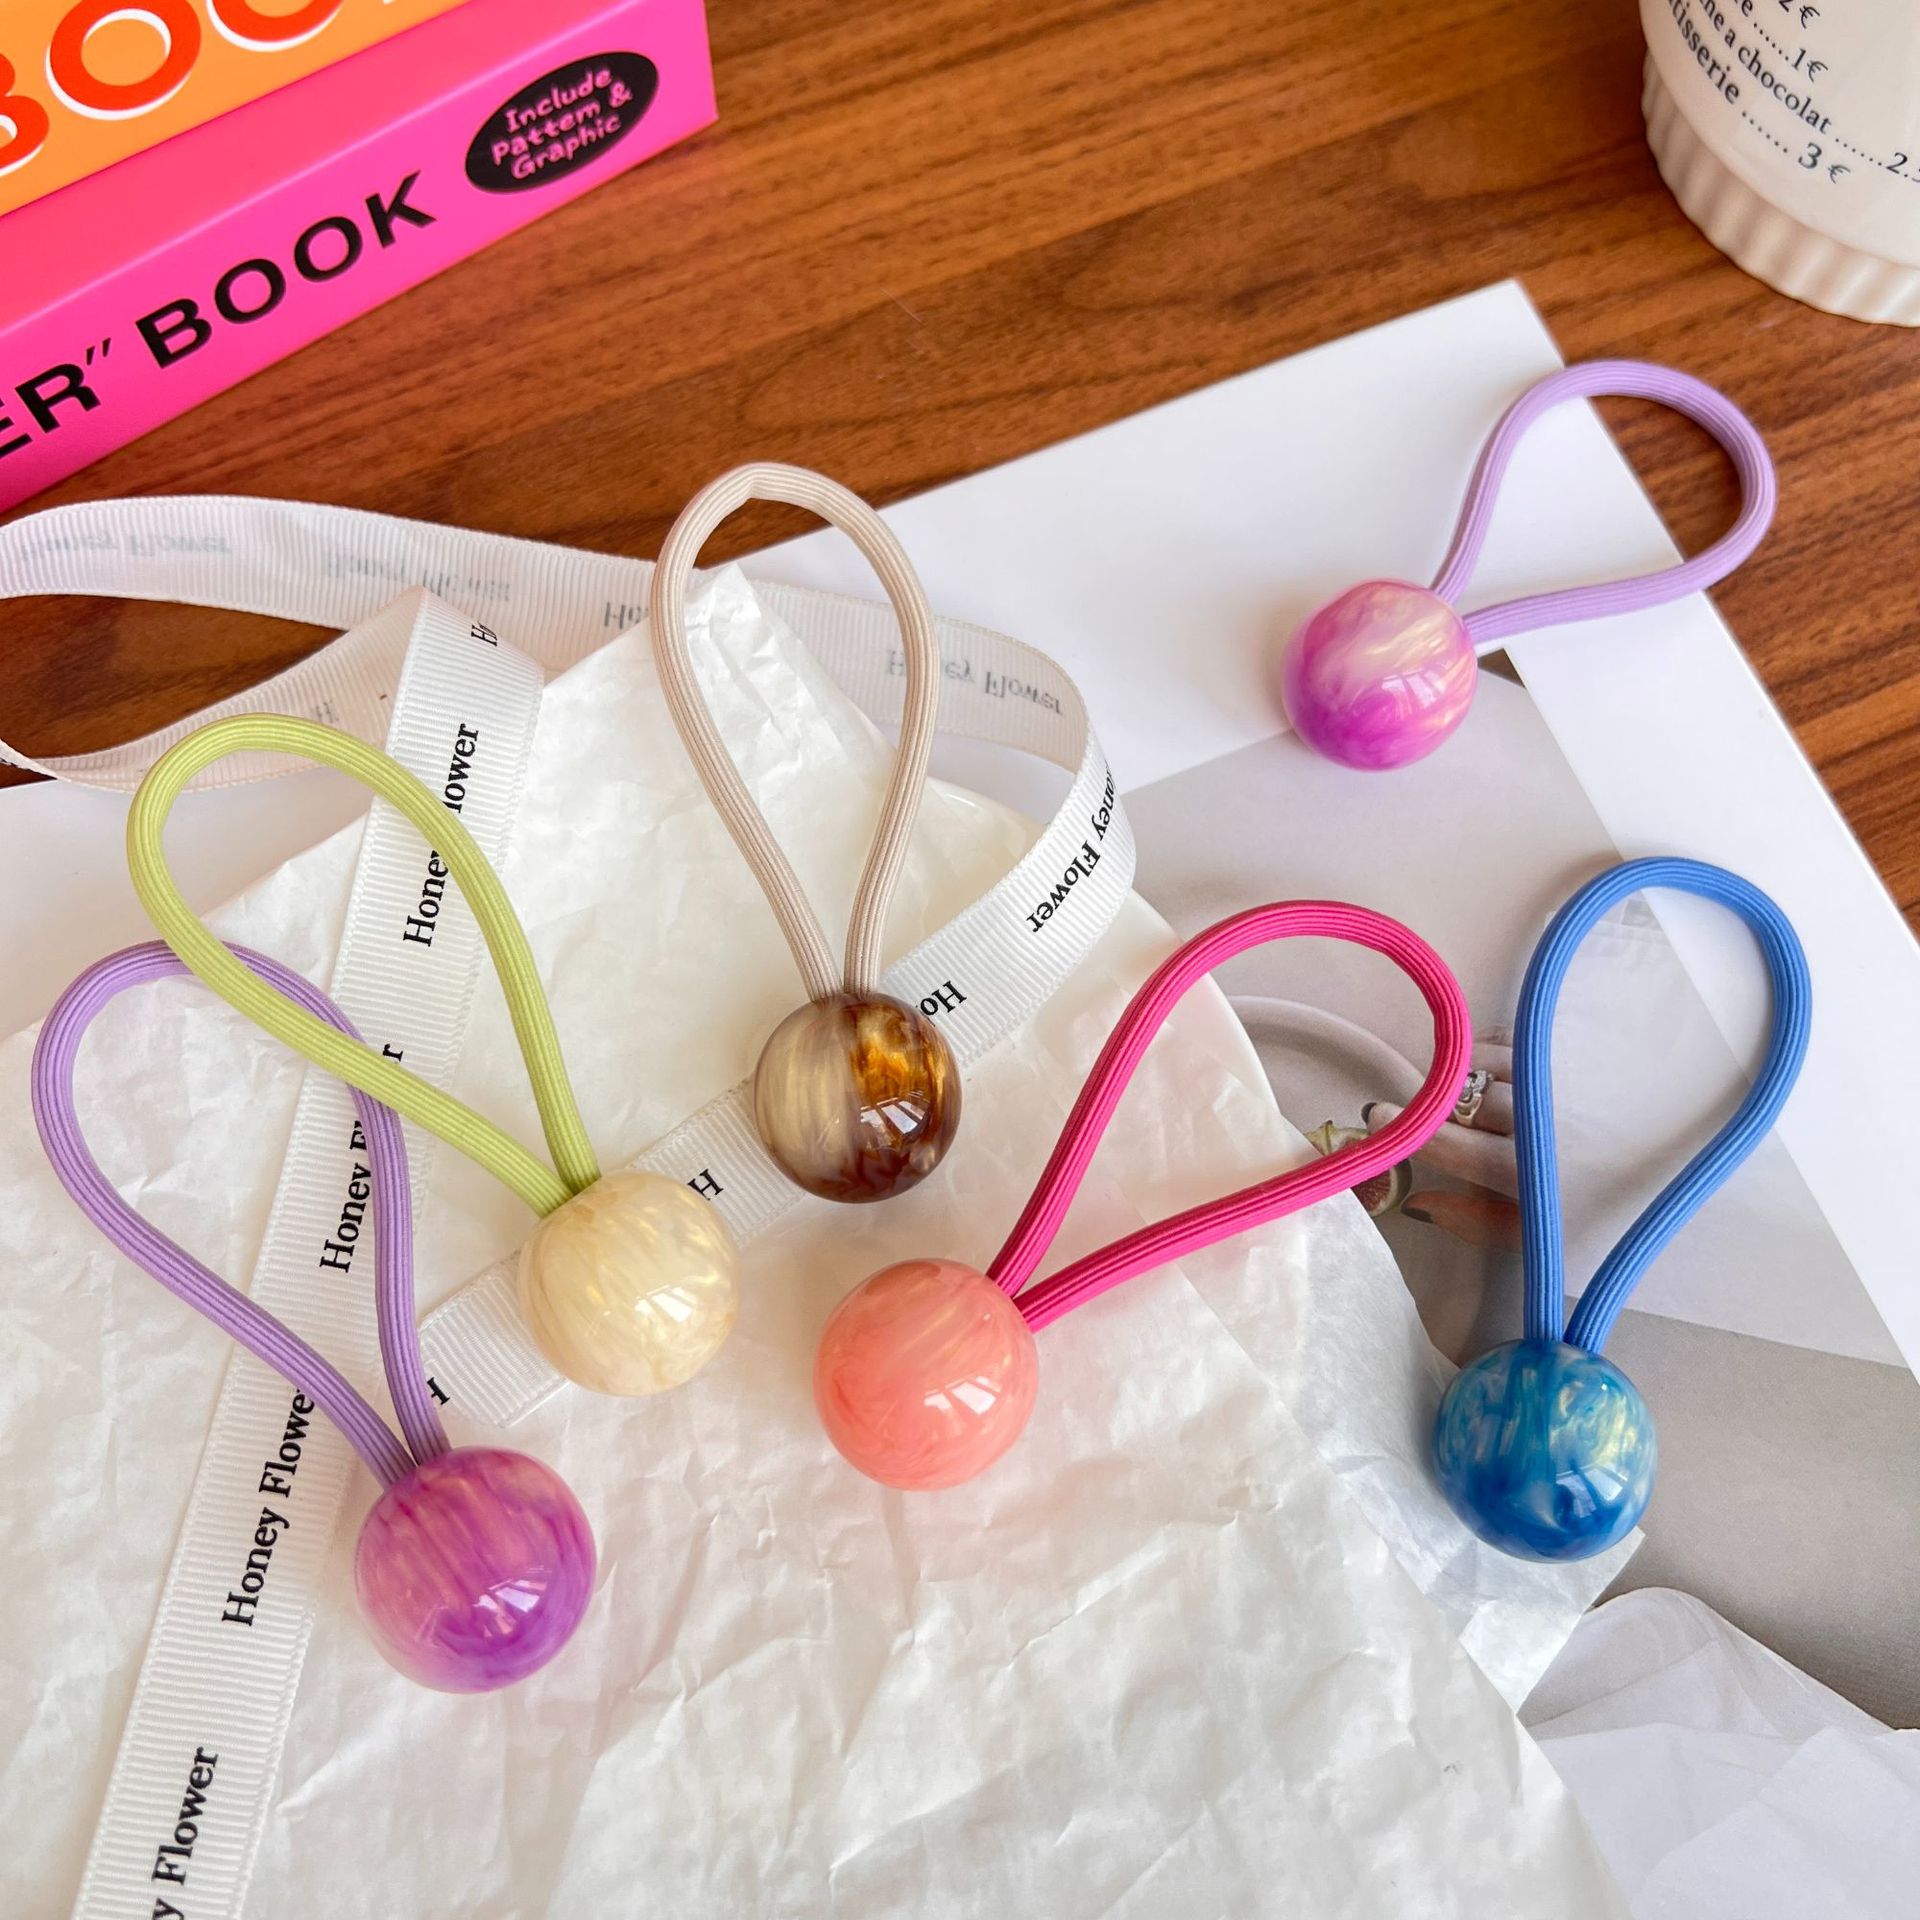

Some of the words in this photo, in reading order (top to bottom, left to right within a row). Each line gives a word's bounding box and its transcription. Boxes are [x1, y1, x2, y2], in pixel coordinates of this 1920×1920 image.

[504, 69, 612, 133] Include
[609, 81, 633, 109] &
[1669, 0, 1740, 104] tisserie
[1724, 28, 1736, 48] a
[1738, 46, 1832, 134] chocolat
[511, 114, 621, 179] Graphic
[135, 170, 436, 368] BOOK
[403, 850, 449, 947] Hone
[443, 723, 479, 814] lower
[1091, 760, 1115, 841] oney
[1025, 840, 1101, 932] Flower
[222, 1507, 290, 1627] Honey
[259, 1388, 315, 1498] Flowe
[152, 1746, 218, 1886] Flower
